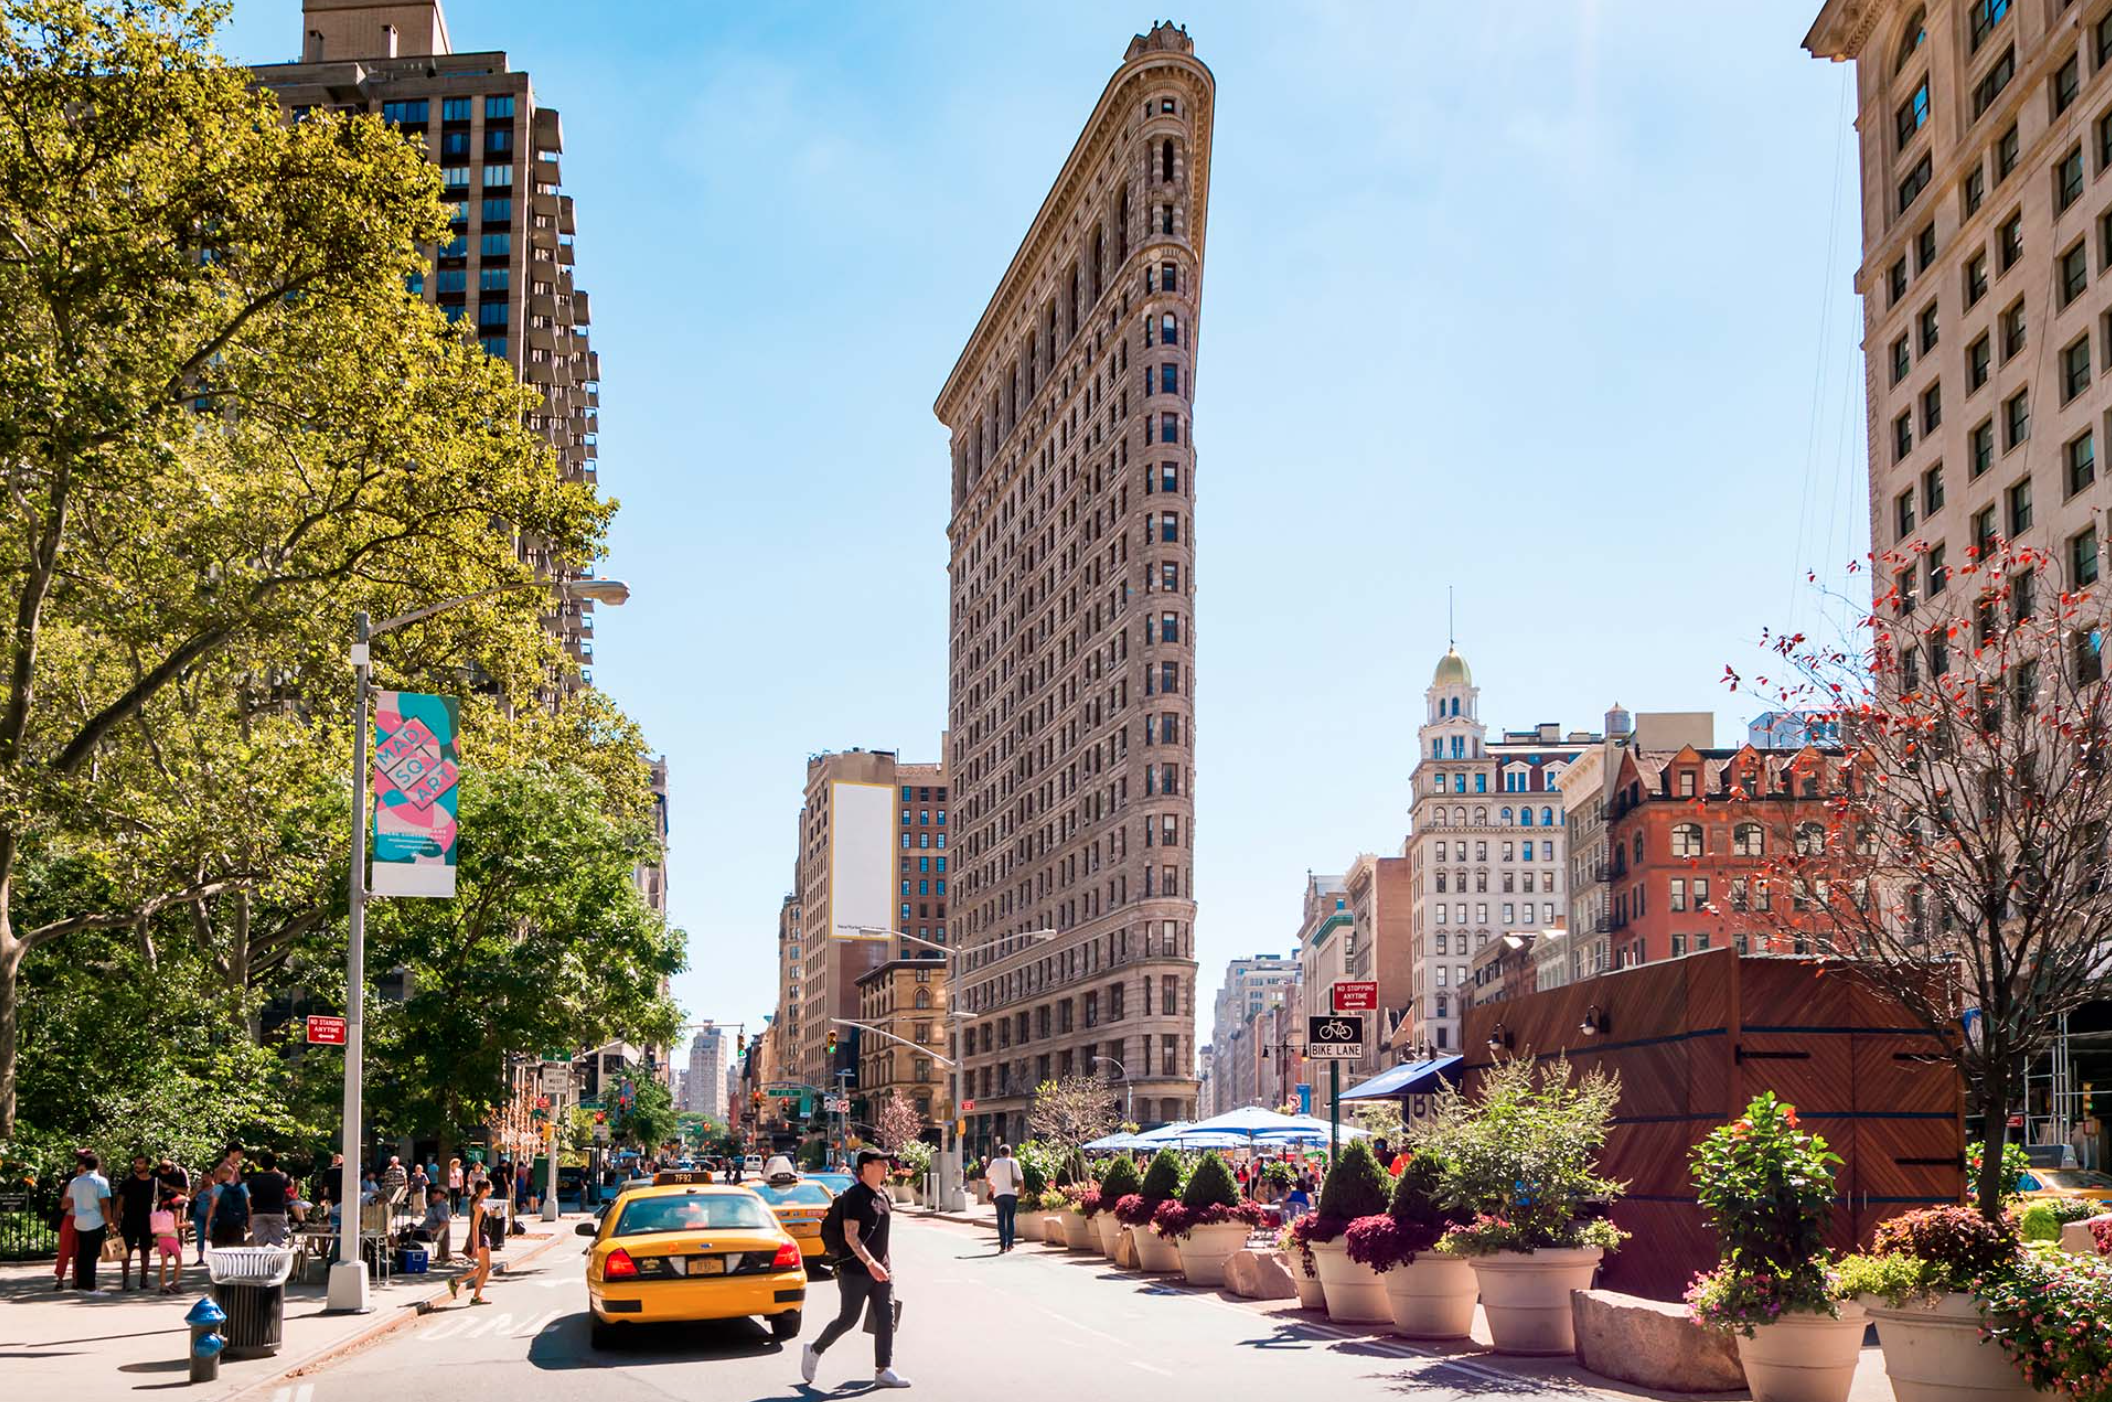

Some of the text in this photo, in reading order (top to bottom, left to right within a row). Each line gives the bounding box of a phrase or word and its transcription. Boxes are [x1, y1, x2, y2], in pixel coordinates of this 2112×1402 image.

[1347, 984, 1374, 992] STOPPING
[1343, 992, 1369, 1000] ANYTIME
[320, 1019, 343, 1027] STANDING
[1312, 1045, 1361, 1055] BIKE LANE
[674, 1174, 692, 1182] 7F92
